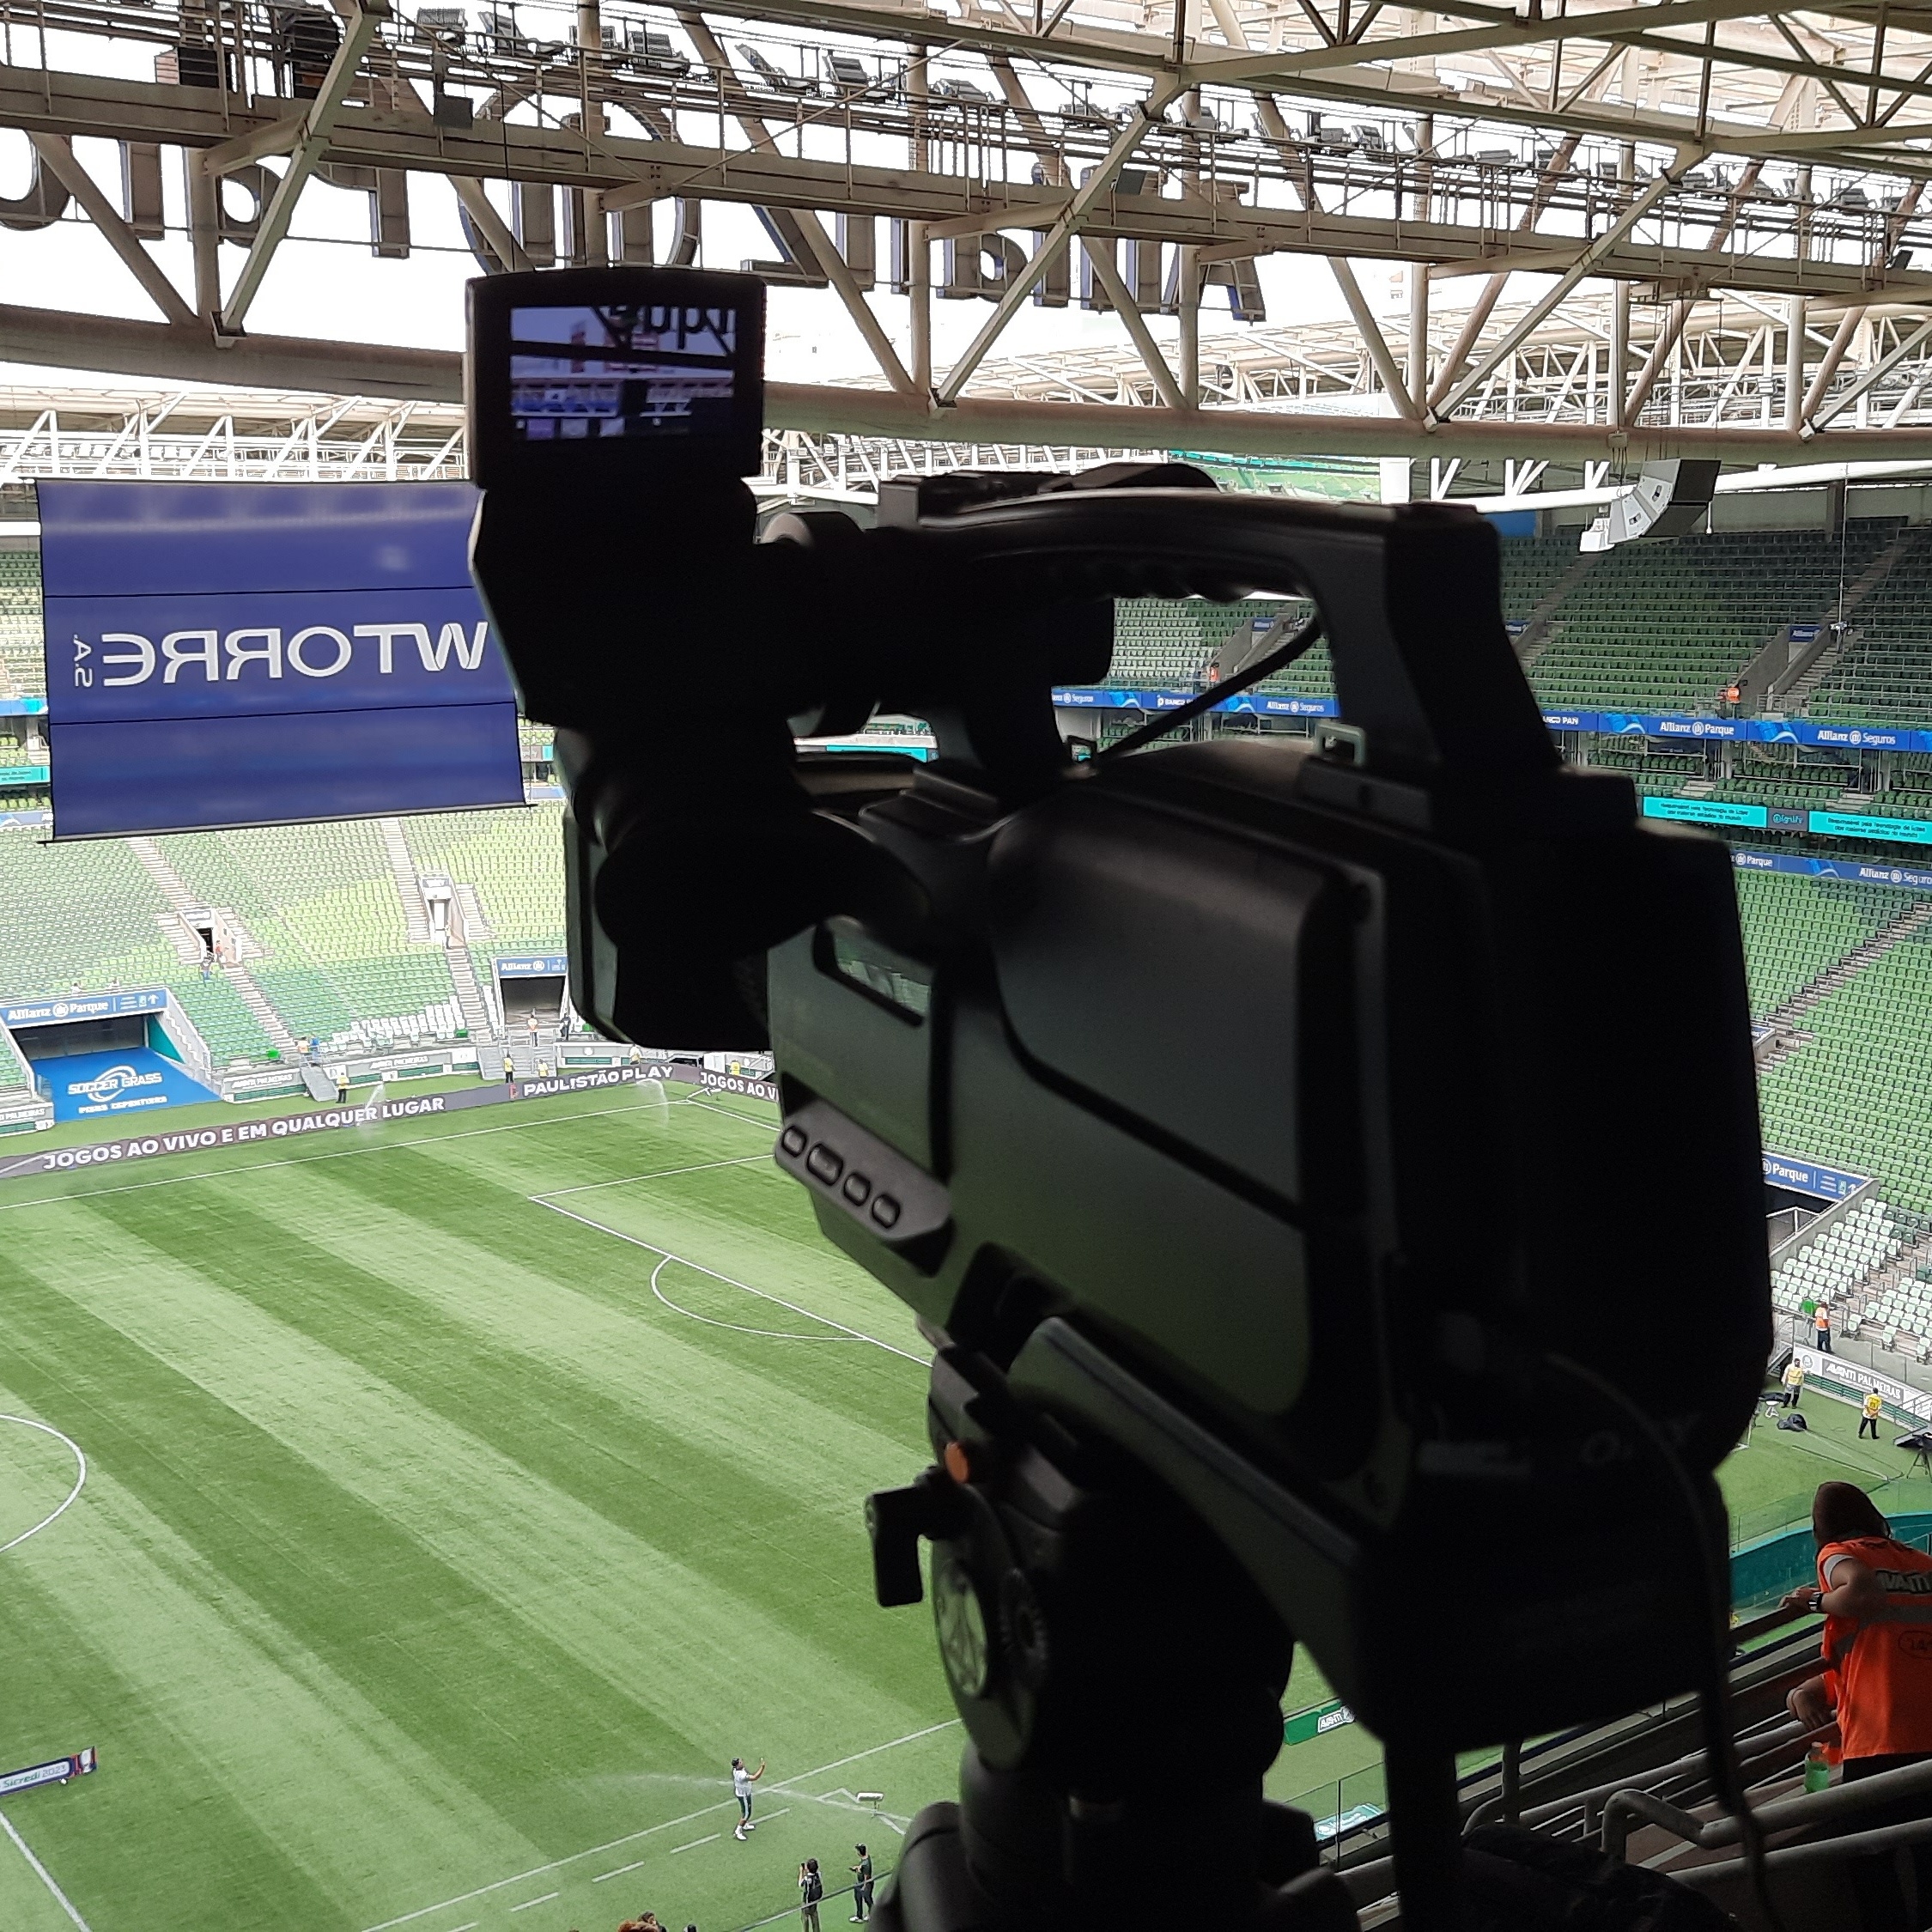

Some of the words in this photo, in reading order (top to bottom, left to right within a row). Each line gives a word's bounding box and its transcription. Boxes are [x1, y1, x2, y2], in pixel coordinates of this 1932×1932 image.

[1660, 721, 1692, 734] Allianz
[1704, 723, 1735, 736] Parque
[1817, 730, 1848, 742] Allianz
[1862, 732, 1896, 744] Seguros
[1747, 854, 1773, 869] Parque
[1858, 866, 1889, 879] Allianz
[501, 962, 532, 972] Allianz
[8, 1006, 52, 1021] Allianz
[70, 999, 109, 1015] Parque
[68, 1078, 118, 1095] SOCCER
[121, 1072, 163, 1087] GRASS
[523, 1069, 620, 1097] PAULISTÃO
[622, 1066, 674, 1082] PLAY
[701, 1072, 744, 1093] JOGOS
[747, 1083, 766, 1097] AO
[43, 1145, 122, 1170] JOGOS
[126, 1139, 159, 1157] AO
[162, 1131, 216, 1151] VIVO
[222, 1128, 233, 1143] E
[238, 1121, 267, 1140] EM
[271, 1107, 378, 1133] QUALQUER
[383, 1097, 445, 1118] LUGAR
[1772, 1162, 1808, 1183] Parque
[3, 1771, 40, 1788] Sicredi
